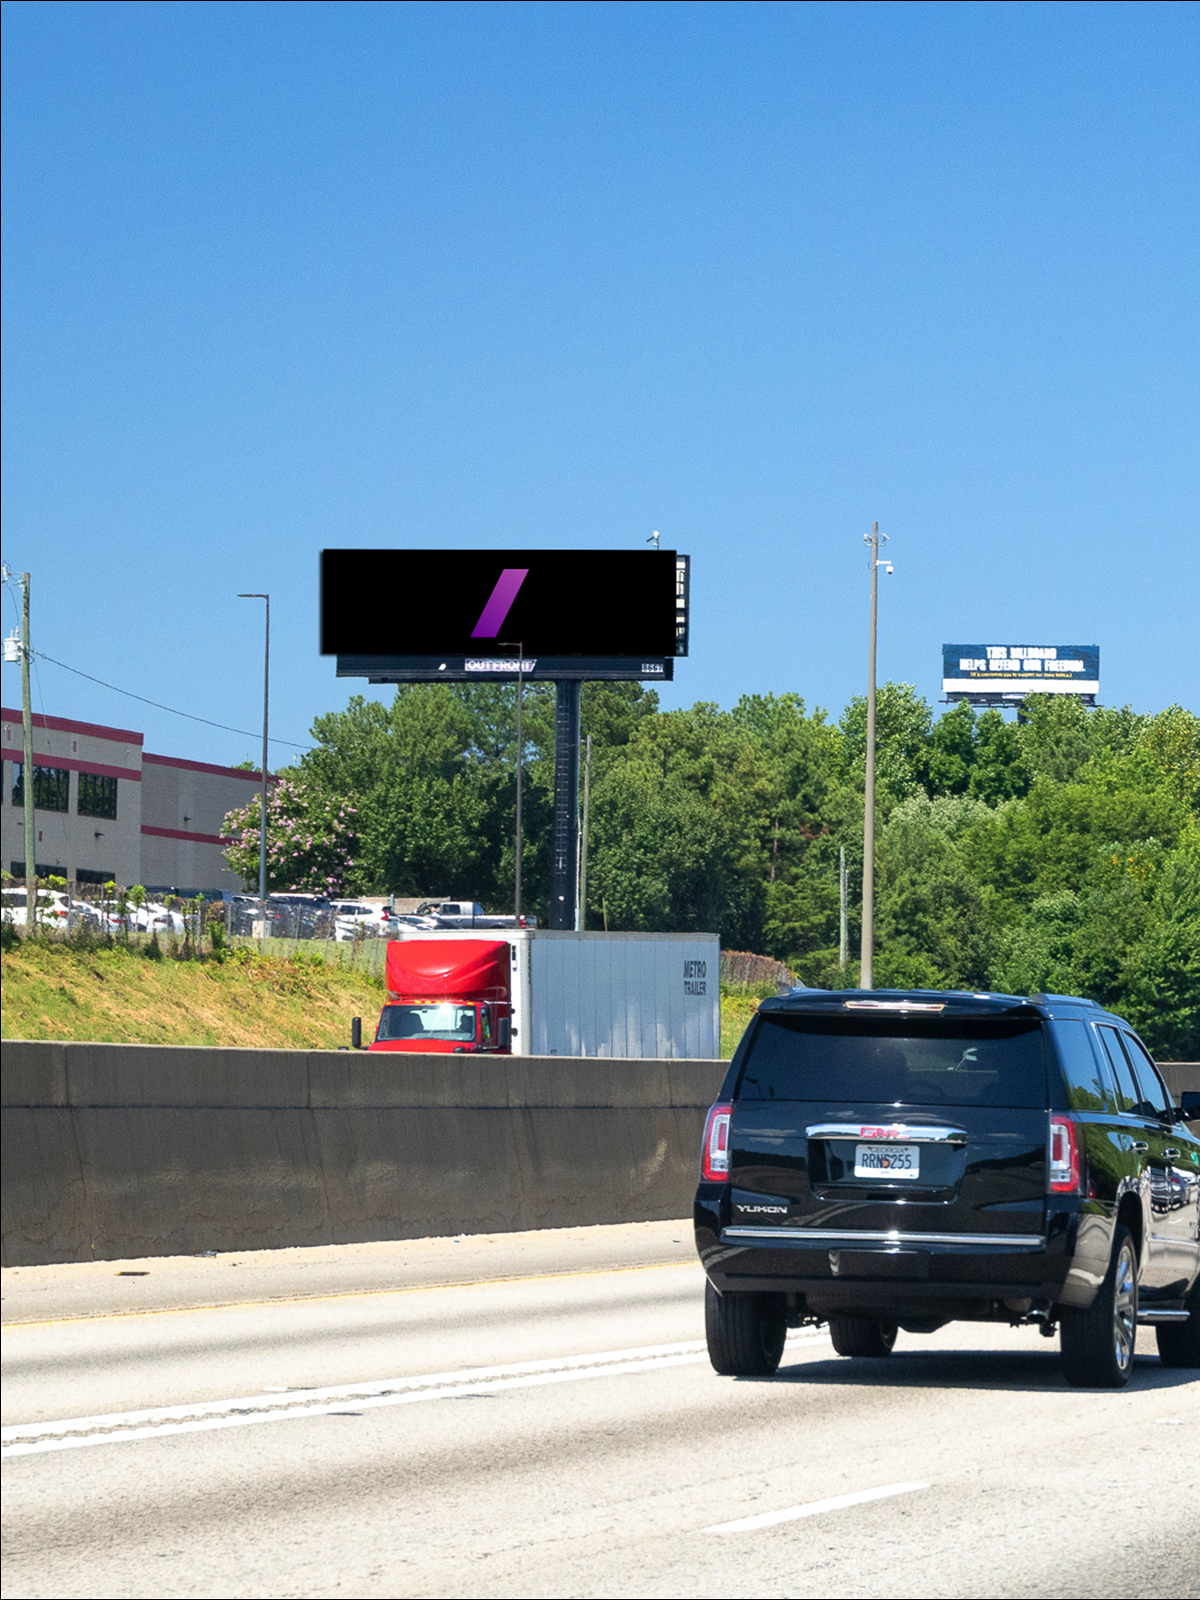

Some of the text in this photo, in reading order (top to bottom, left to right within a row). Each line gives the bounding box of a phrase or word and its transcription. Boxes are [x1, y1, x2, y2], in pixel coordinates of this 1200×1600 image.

[683, 960, 707, 978] METRO
[683, 981, 707, 996] TRAILER
[860, 1127, 910, 1139] GMC
[861, 1153, 912, 1170] RRN5255
[736, 1205, 788, 1214] YUKON
